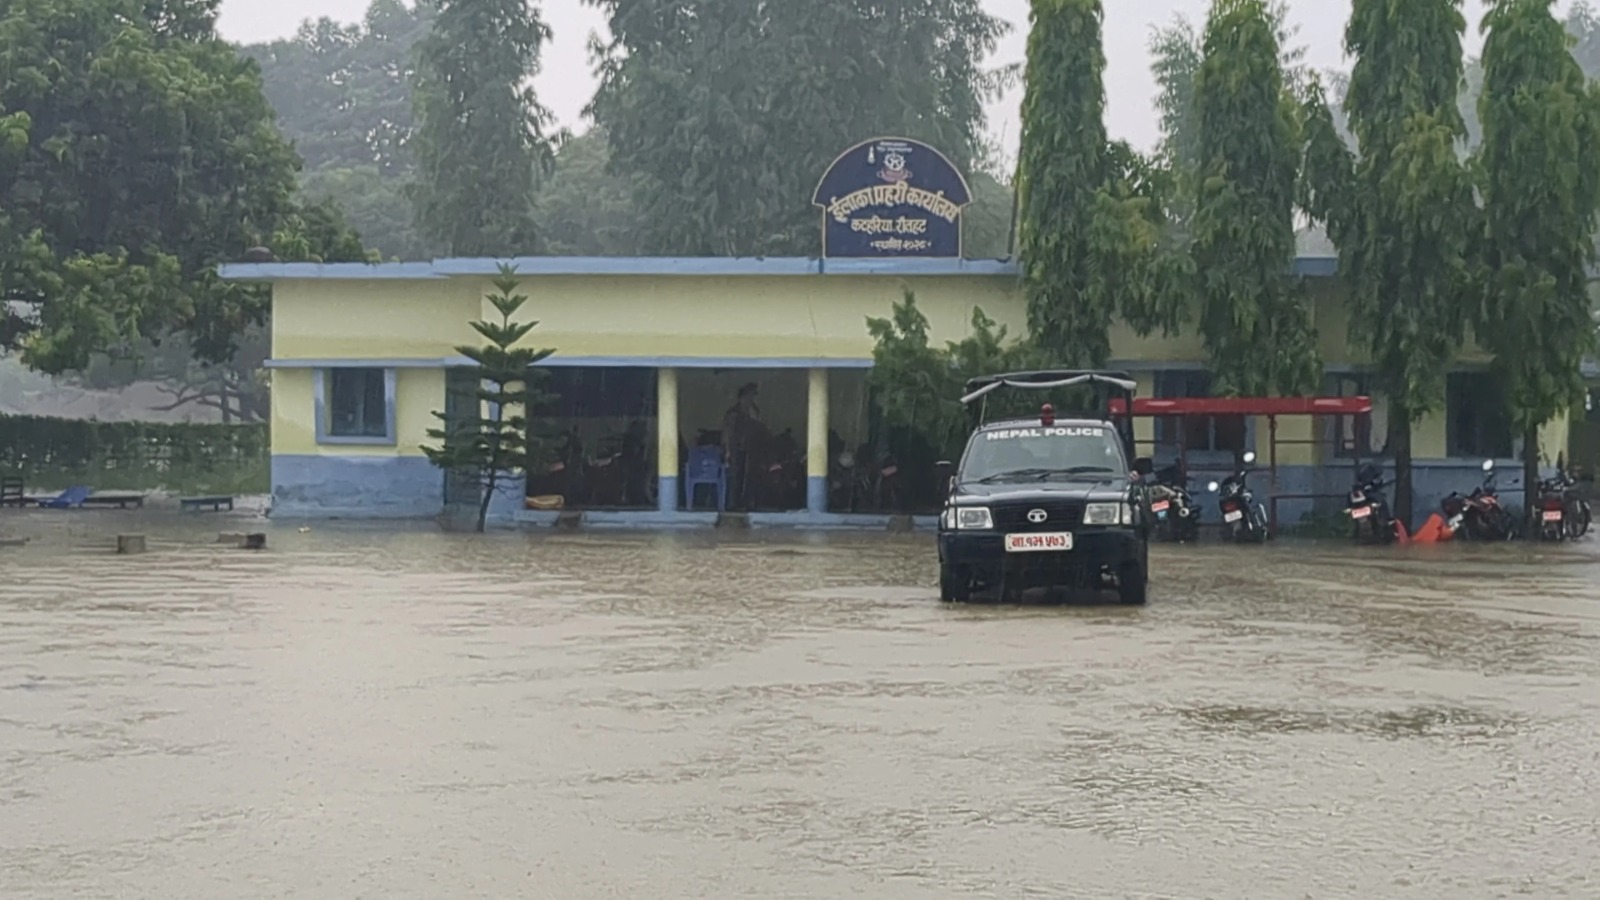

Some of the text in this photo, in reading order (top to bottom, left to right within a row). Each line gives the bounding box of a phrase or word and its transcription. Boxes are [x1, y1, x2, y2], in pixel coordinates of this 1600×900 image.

[873, 181, 908, 207] प्रहरी
[906, 187, 960, 223] कार्यालय
[987, 428, 1103, 441] NEPAL POLICE
